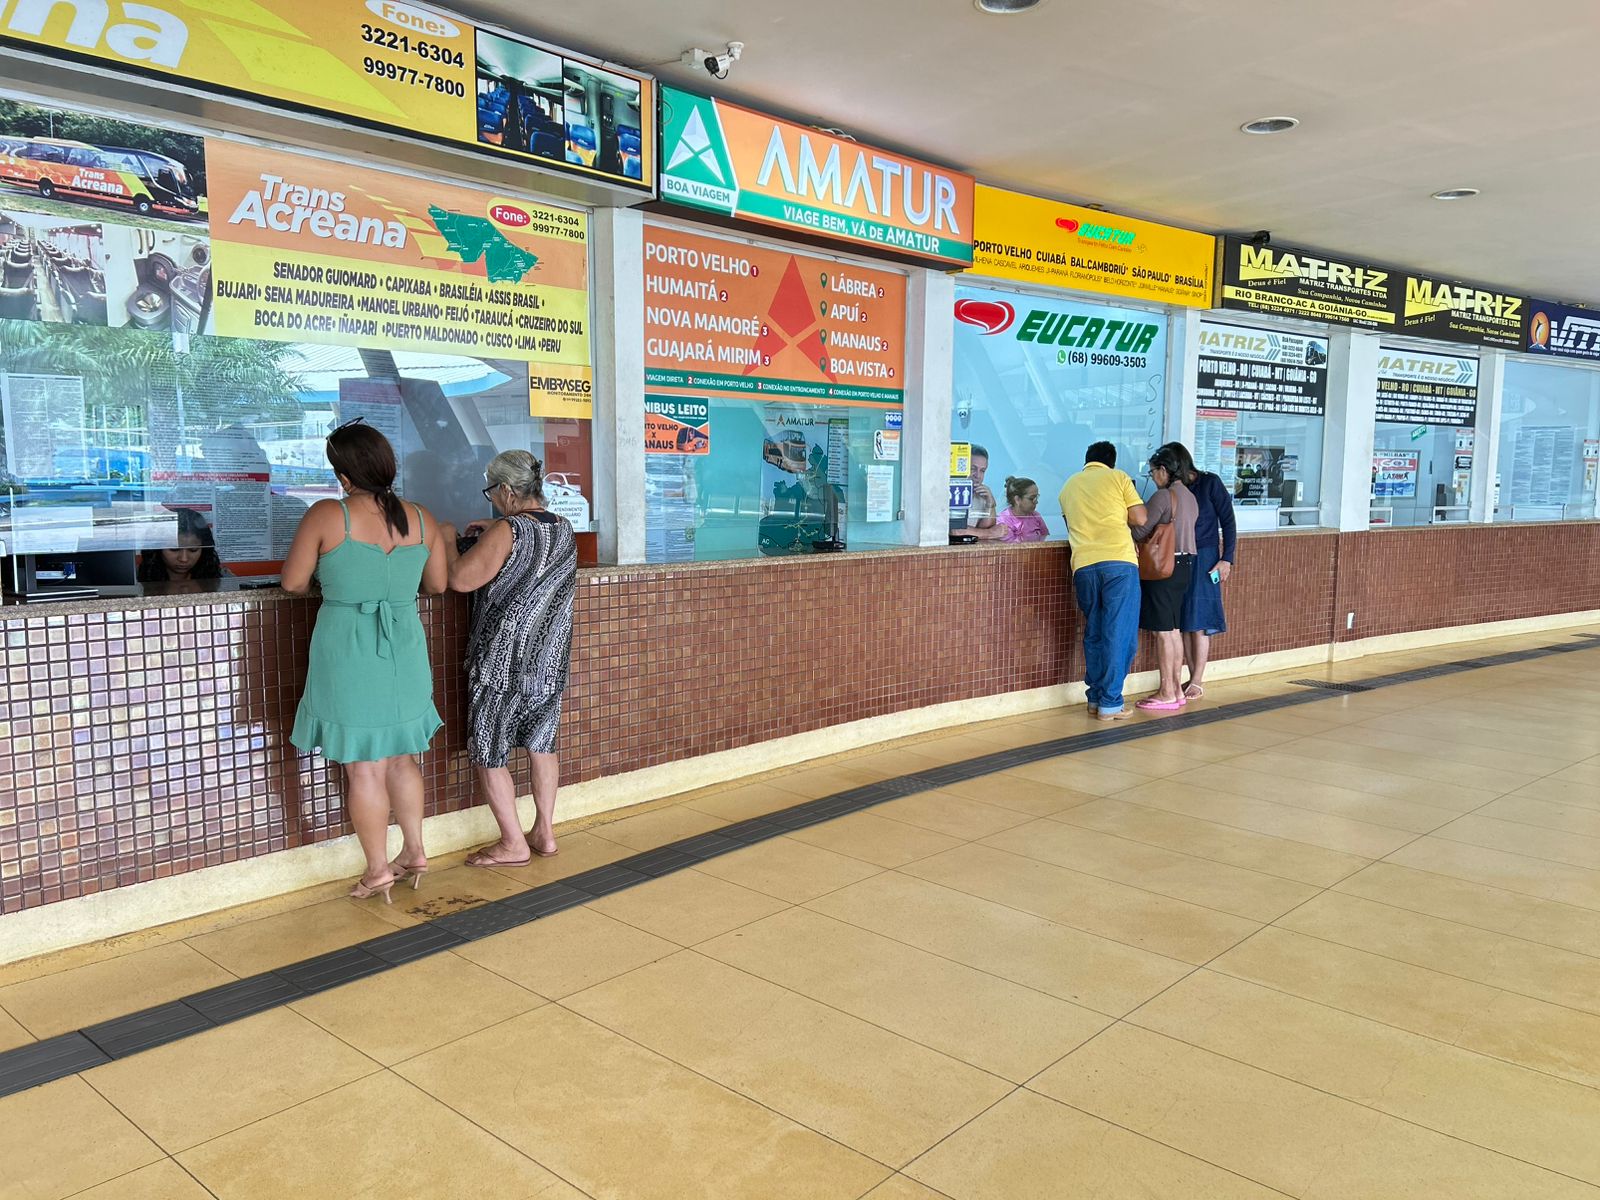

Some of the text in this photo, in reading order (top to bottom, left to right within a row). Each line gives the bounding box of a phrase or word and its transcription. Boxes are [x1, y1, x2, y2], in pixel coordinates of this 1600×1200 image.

[381, 2, 446, 35] Fone:
[0, 0, 188, 68] na
[361, 24, 464, 68] 3221-6304
[363, 57, 465, 98] 99977-7800
[72, 175, 123, 194] Acreana
[79, 168, 105, 179] Trans
[757, 125, 960, 235] AMATUR
[260, 173, 347, 212] Trans
[667, 179, 730, 203] BOA VIAGEM
[228, 190, 407, 249] Acreana
[495, 207, 528, 225] Fone:
[532, 209, 580, 226] 3221-6304
[532, 222, 585, 240] 99977-7800
[783, 205, 939, 254] VIAGE BEM, VÁ DE AMATUR
[1078, 223, 1136, 245] EUCATUR
[646, 242, 698, 268] PORTO
[700, 251, 750, 278] VELHO
[973, 240, 1003, 255] PORTO
[1004, 245, 1032, 259] VELHO
[1036, 251, 1066, 266] CUIABÁ
[1132, 265, 1146, 279] SÃO
[1174, 275, 1204, 289] BRASÍLIA
[1240, 244, 1388, 293] MATRIZ
[273, 261, 540, 309] SENADOR GUIOMARD CAPIXABA BRASILÉIA ASSIS BRASIL
[646, 274, 718, 302] HUMAITÁ
[831, 274, 876, 298] LÁBREA
[1297, 287, 1308, 295] Sua
[1299, 278, 1387, 299] MATRIZ TRANSPORTES LTDA
[217, 280, 583, 335] BUJARI SENA MADUREIRA MANOEL URBANO FEIJÓ TARAUCÁ CRUZEIRO DO SUL
[1235, 289, 1252, 299] RIO
[1254, 291, 1308, 308] BRANCO-AC
[1318, 301, 1367, 318] GOIÂNIA-GO
[1407, 277, 1522, 321] MATRIZ
[646, 306, 691, 329] NOVA
[694, 314, 759, 337] MAMORÉ
[831, 303, 859, 322] APUÍ
[1451, 310, 1521, 328] MATRIZ TRANSPORTES LTDA
[254, 309, 561, 353] BOCA DO ACRE IÑAPARI PUERTO MALDONADO CUSCO LIMA PERU
[831, 330, 881, 351] MANAUS
[1016, 309, 1159, 354] EUCATUR
[647, 338, 716, 362] GUAJARÁ
[718, 346, 761, 367] MIRIM
[1068, 350, 1147, 368] (68) 99609-3503
[830, 358, 856, 376] BOA
[856, 360, 887, 378] VISTA
[1199, 359, 1218, 374] PORTO
[1219, 361, 1236, 376] VELHO
[530, 376, 591, 393] EMBRASEG
[646, 374, 666, 382] VIAGEM
[688, 376, 693, 384] 2
[693, 377, 716, 386] CONEXÃO
[739, 381, 753, 389] VELHO
[758, 382, 762, 390] 3
[763, 383, 782, 391] CONEXÃO
[644, 401, 707, 416] NIBUS LEITO
[657, 423, 678, 431] VELHO
[786, 418, 814, 426] AMATUR
[645, 440, 674, 450] ANAUS
